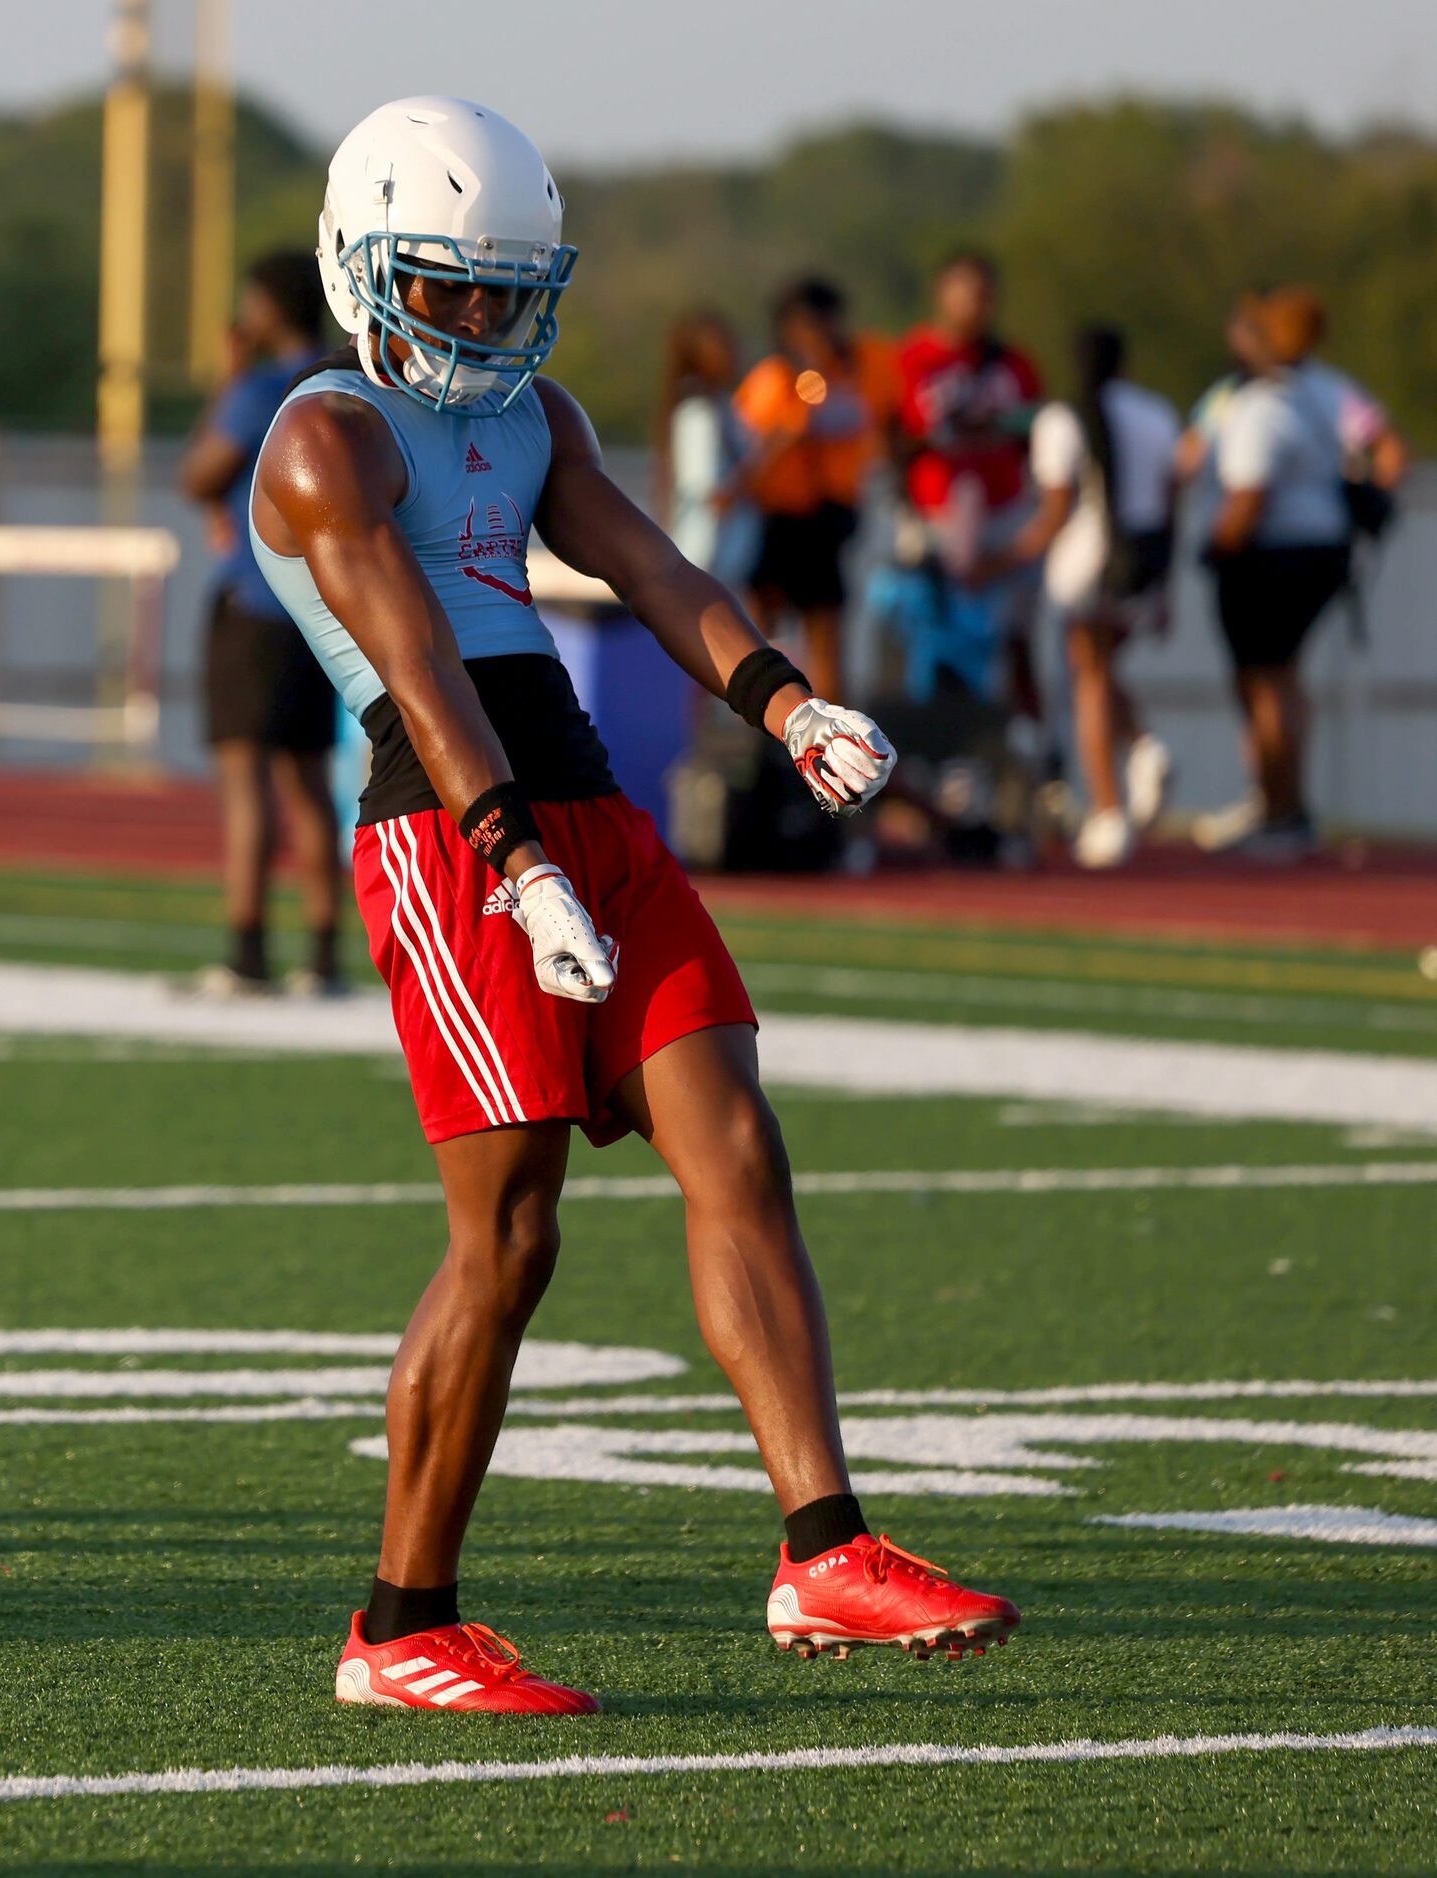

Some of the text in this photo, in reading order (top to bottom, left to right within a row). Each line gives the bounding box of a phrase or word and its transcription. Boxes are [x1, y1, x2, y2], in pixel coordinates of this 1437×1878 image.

[466, 462, 492, 473] adidas
[458, 538, 522, 560] CART
[482, 899, 520, 916] adid
[809, 1554, 849, 1578] COPA
